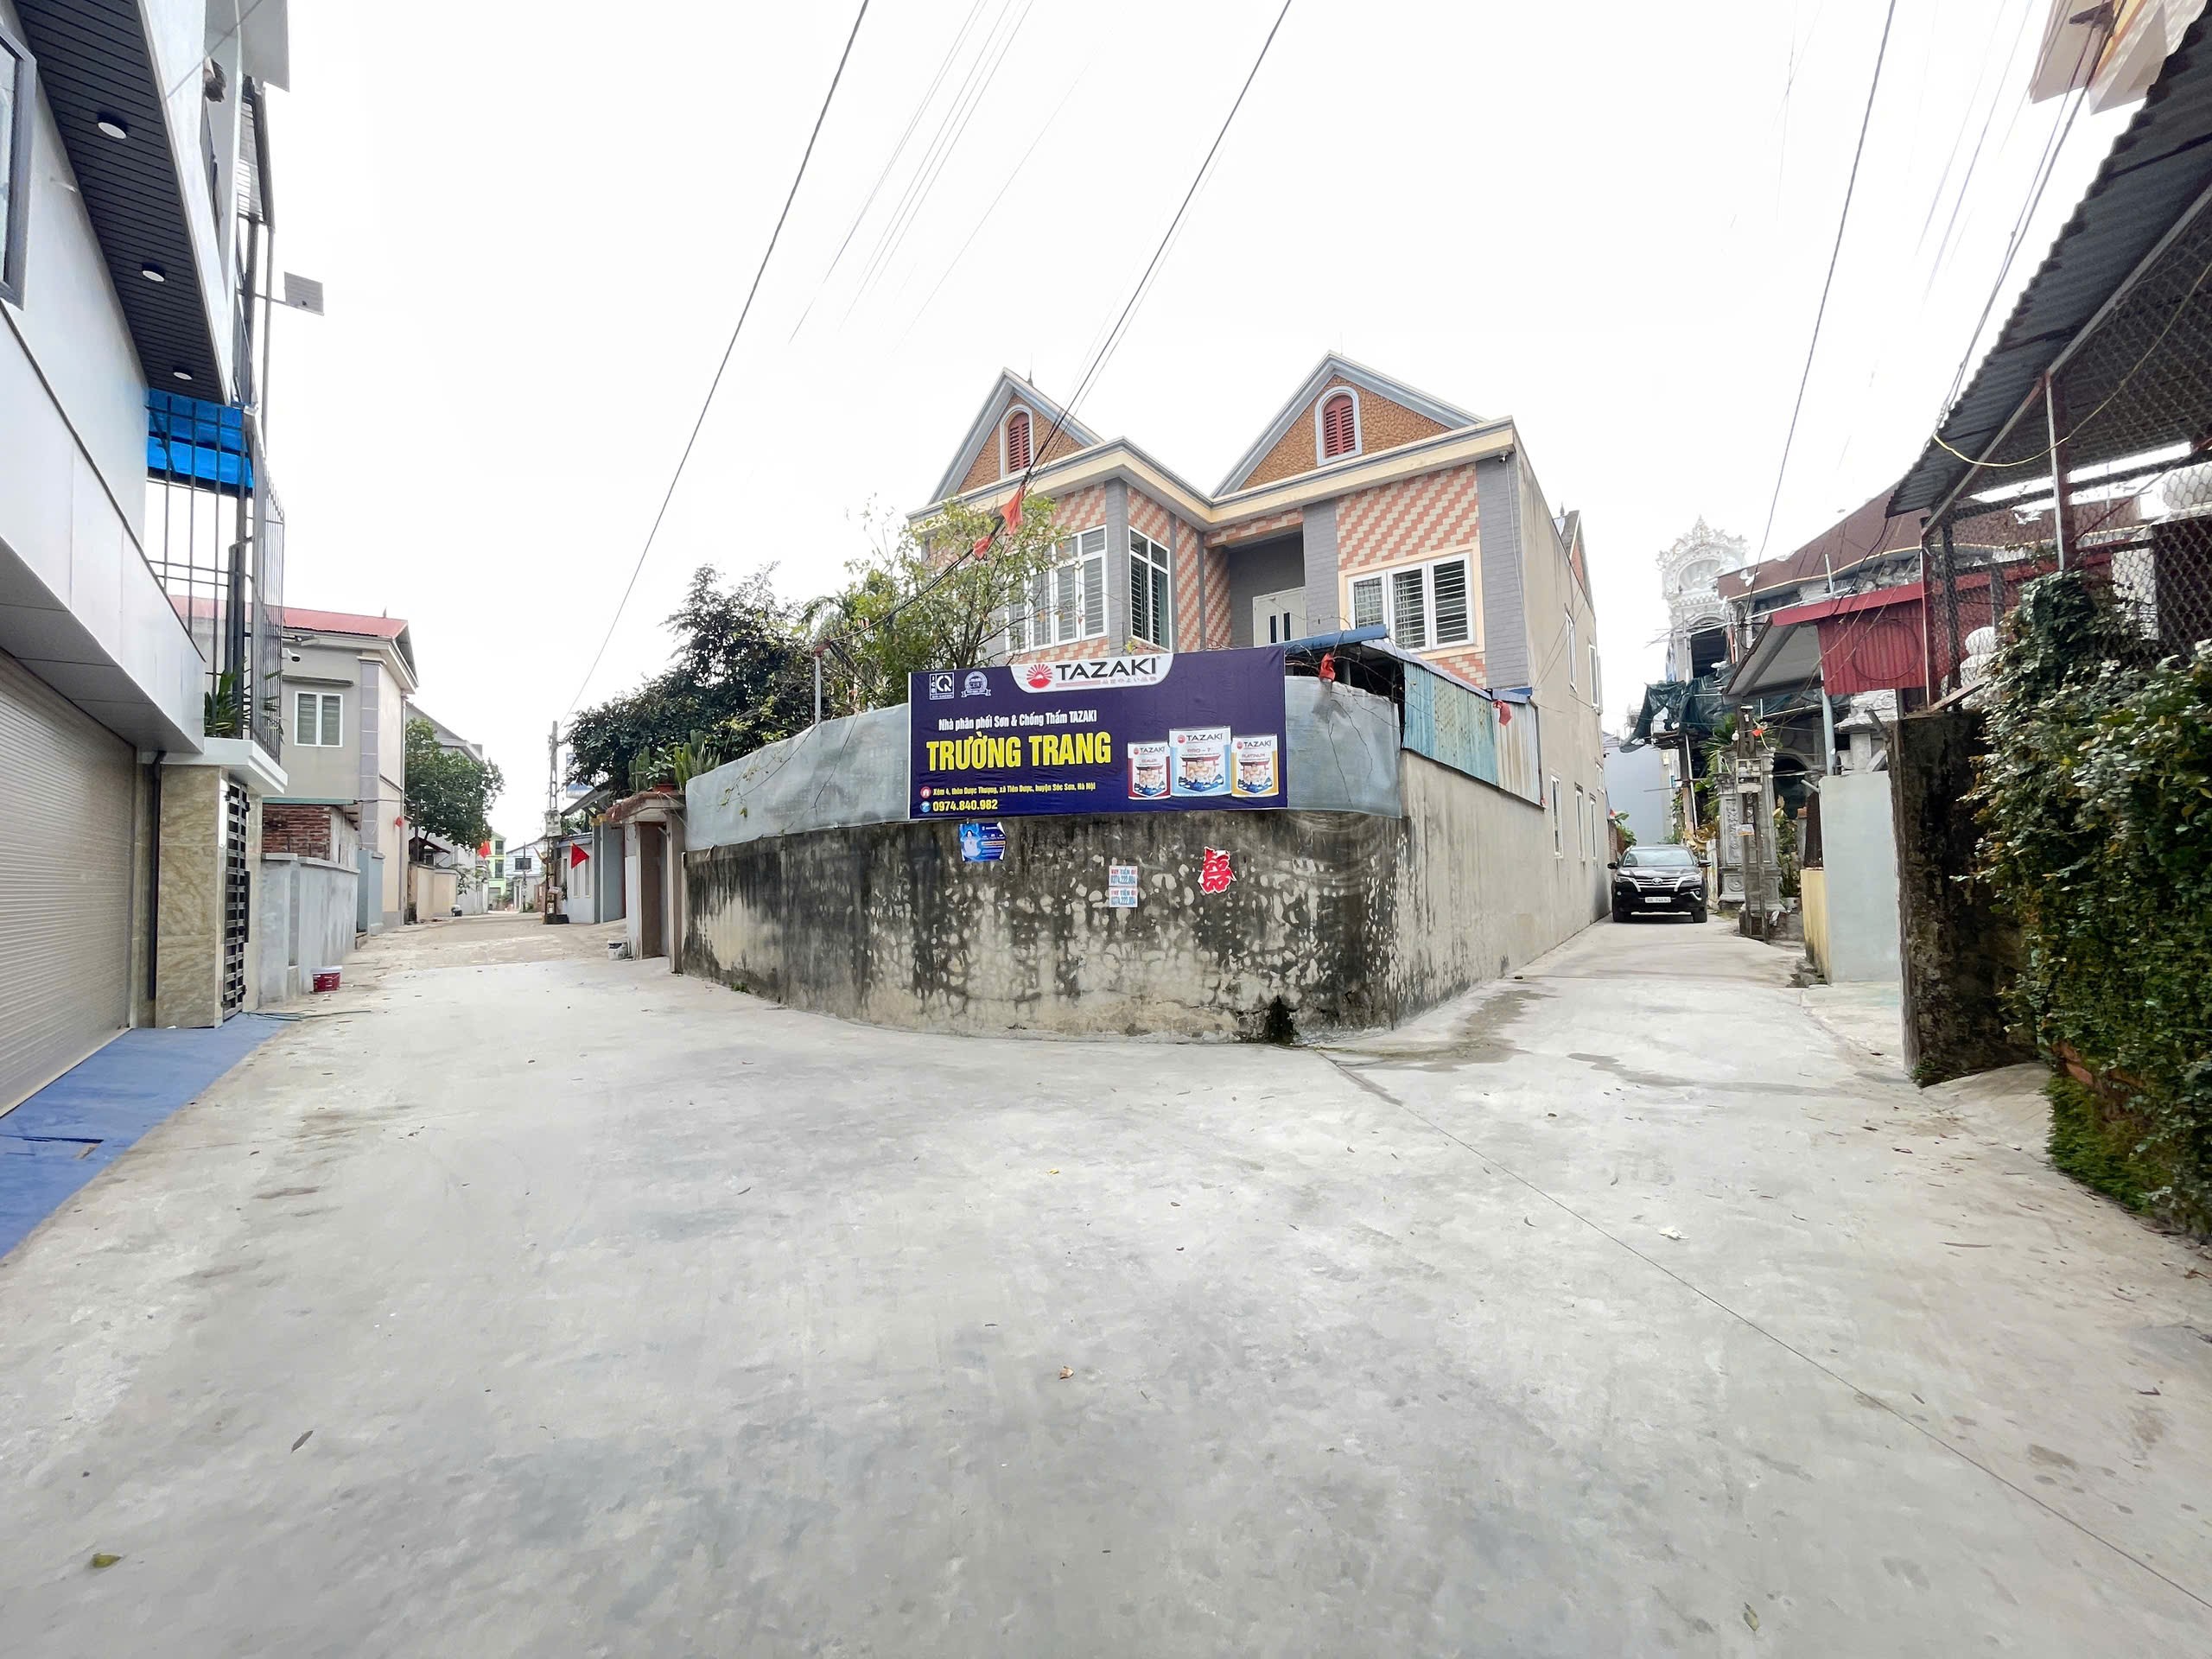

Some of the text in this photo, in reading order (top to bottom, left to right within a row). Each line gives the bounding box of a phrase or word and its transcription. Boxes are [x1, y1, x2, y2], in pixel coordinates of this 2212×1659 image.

[1055, 658, 1156, 681] TAZAKI
[938, 709, 1097, 731] Nhà phân phối Sơn & Chống Thấm TAZAKI
[1185, 733, 1224, 741] TAZAKI
[926, 731, 1111, 772] TRƯỜNG TRANG
[932, 799, 998, 811] 0974.840.982
